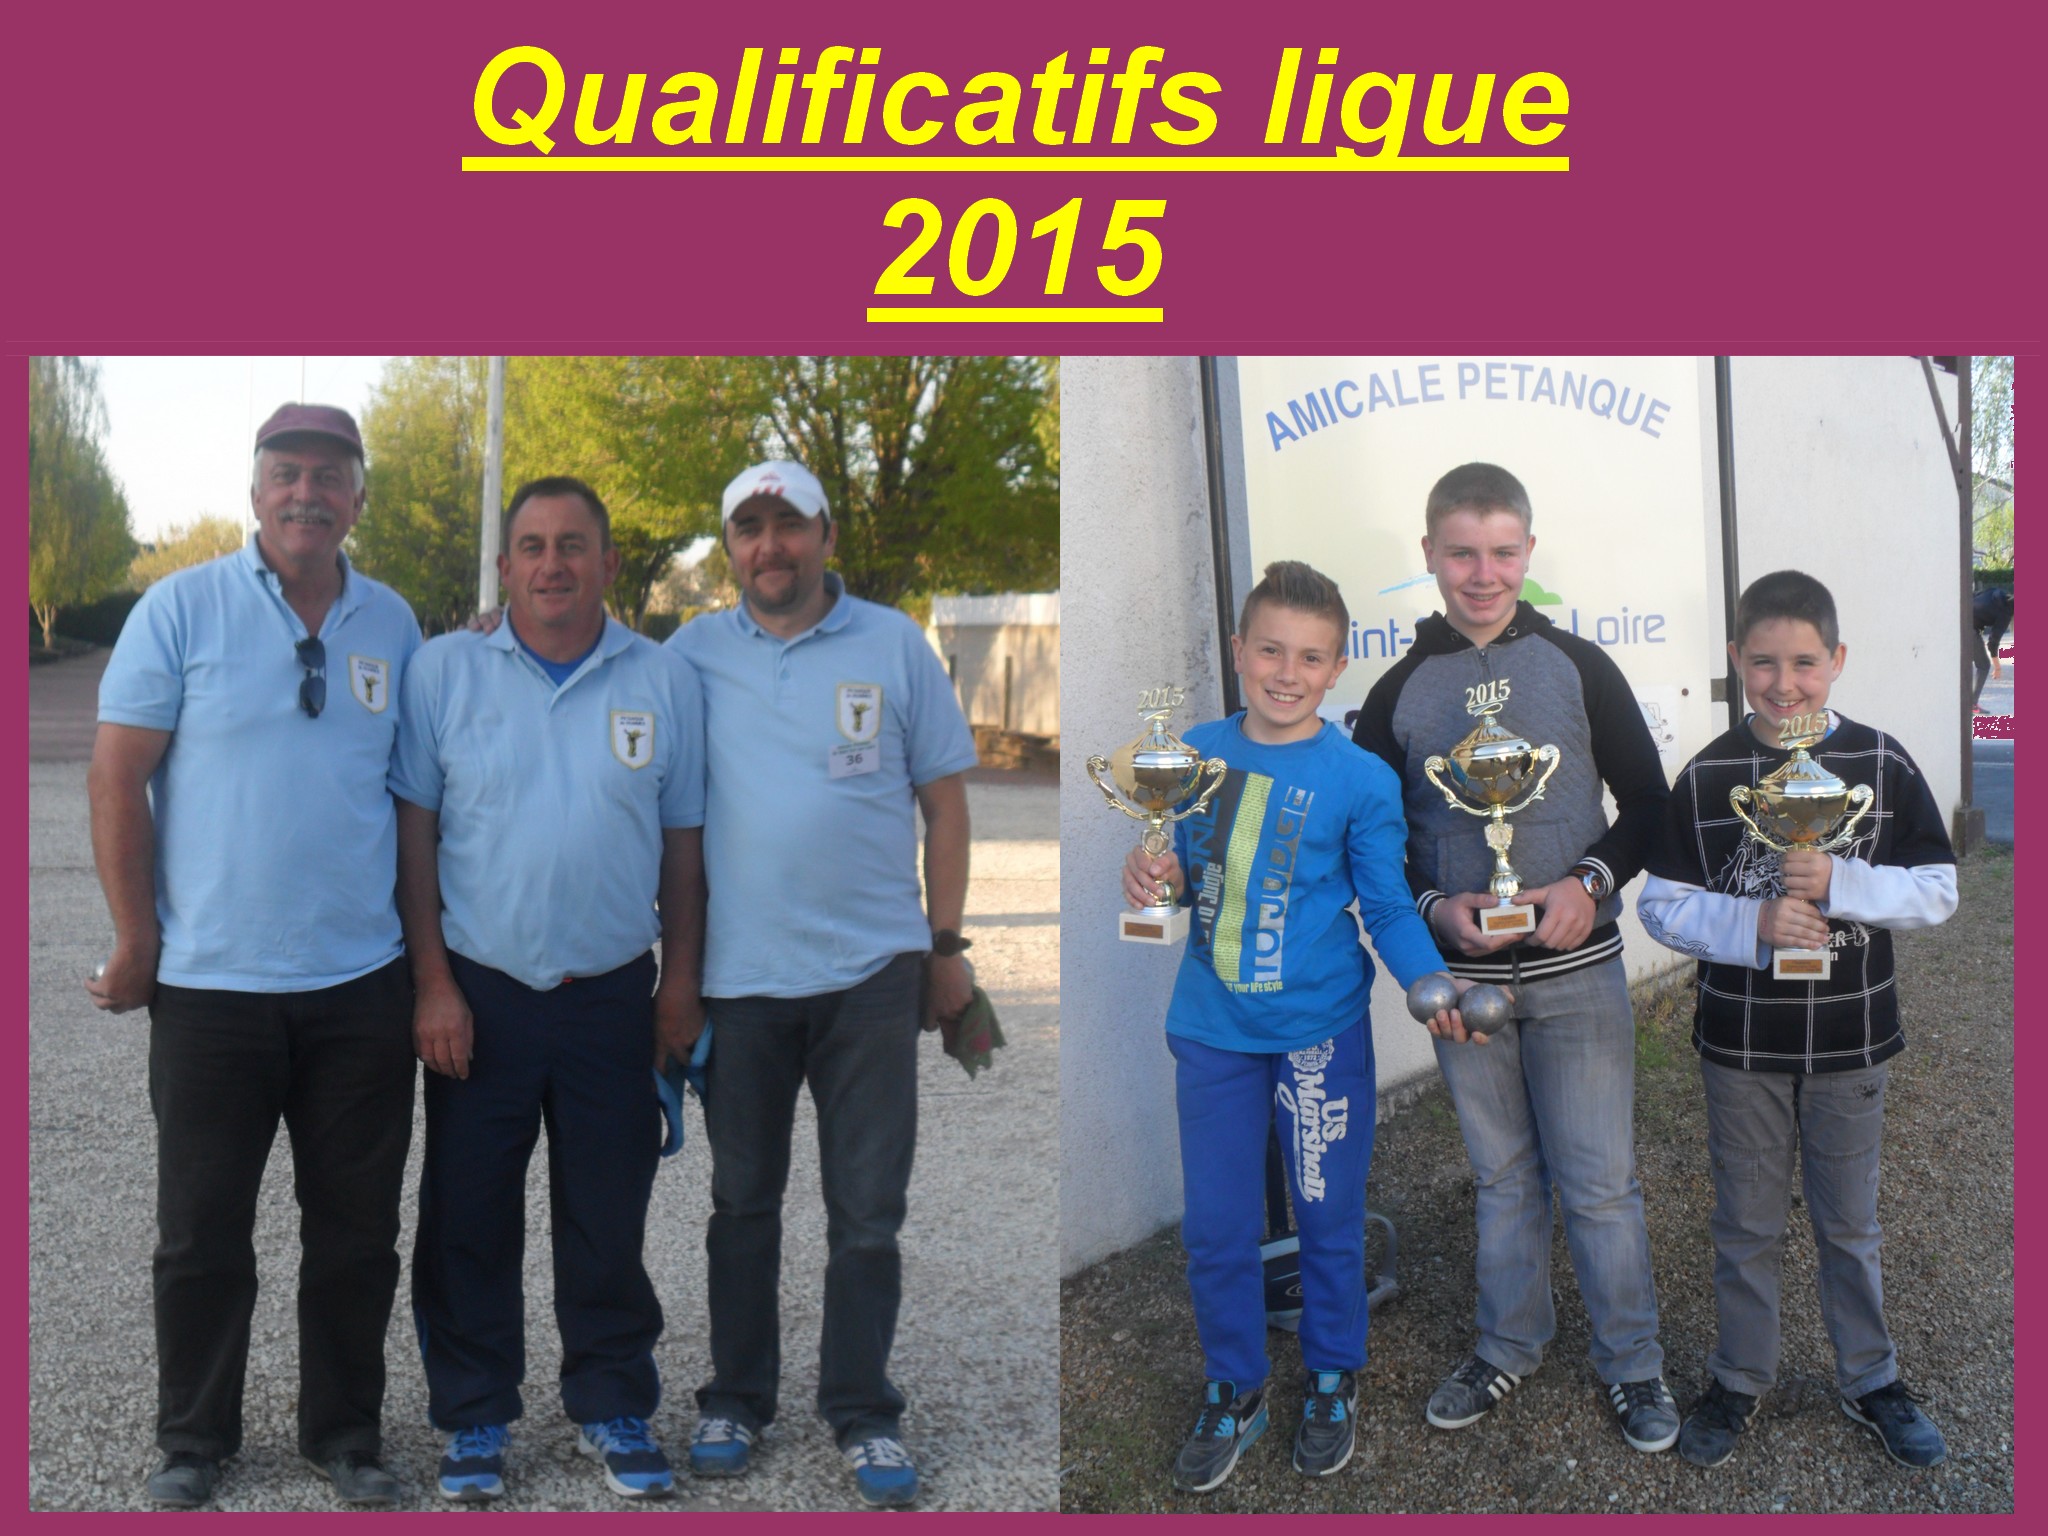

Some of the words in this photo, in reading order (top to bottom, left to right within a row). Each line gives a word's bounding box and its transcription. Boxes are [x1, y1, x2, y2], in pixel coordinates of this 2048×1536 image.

[1265, 363, 1445, 452] AMICALE
[1457, 362, 1671, 440] PETANQUE
[1137, 687, 1185, 709] 2015
[1466, 679, 1511, 707] 2015
[1778, 712, 1829, 738] 2015
[846, 754, 863, 766] 36
[1321, 1096, 1349, 1142] US
